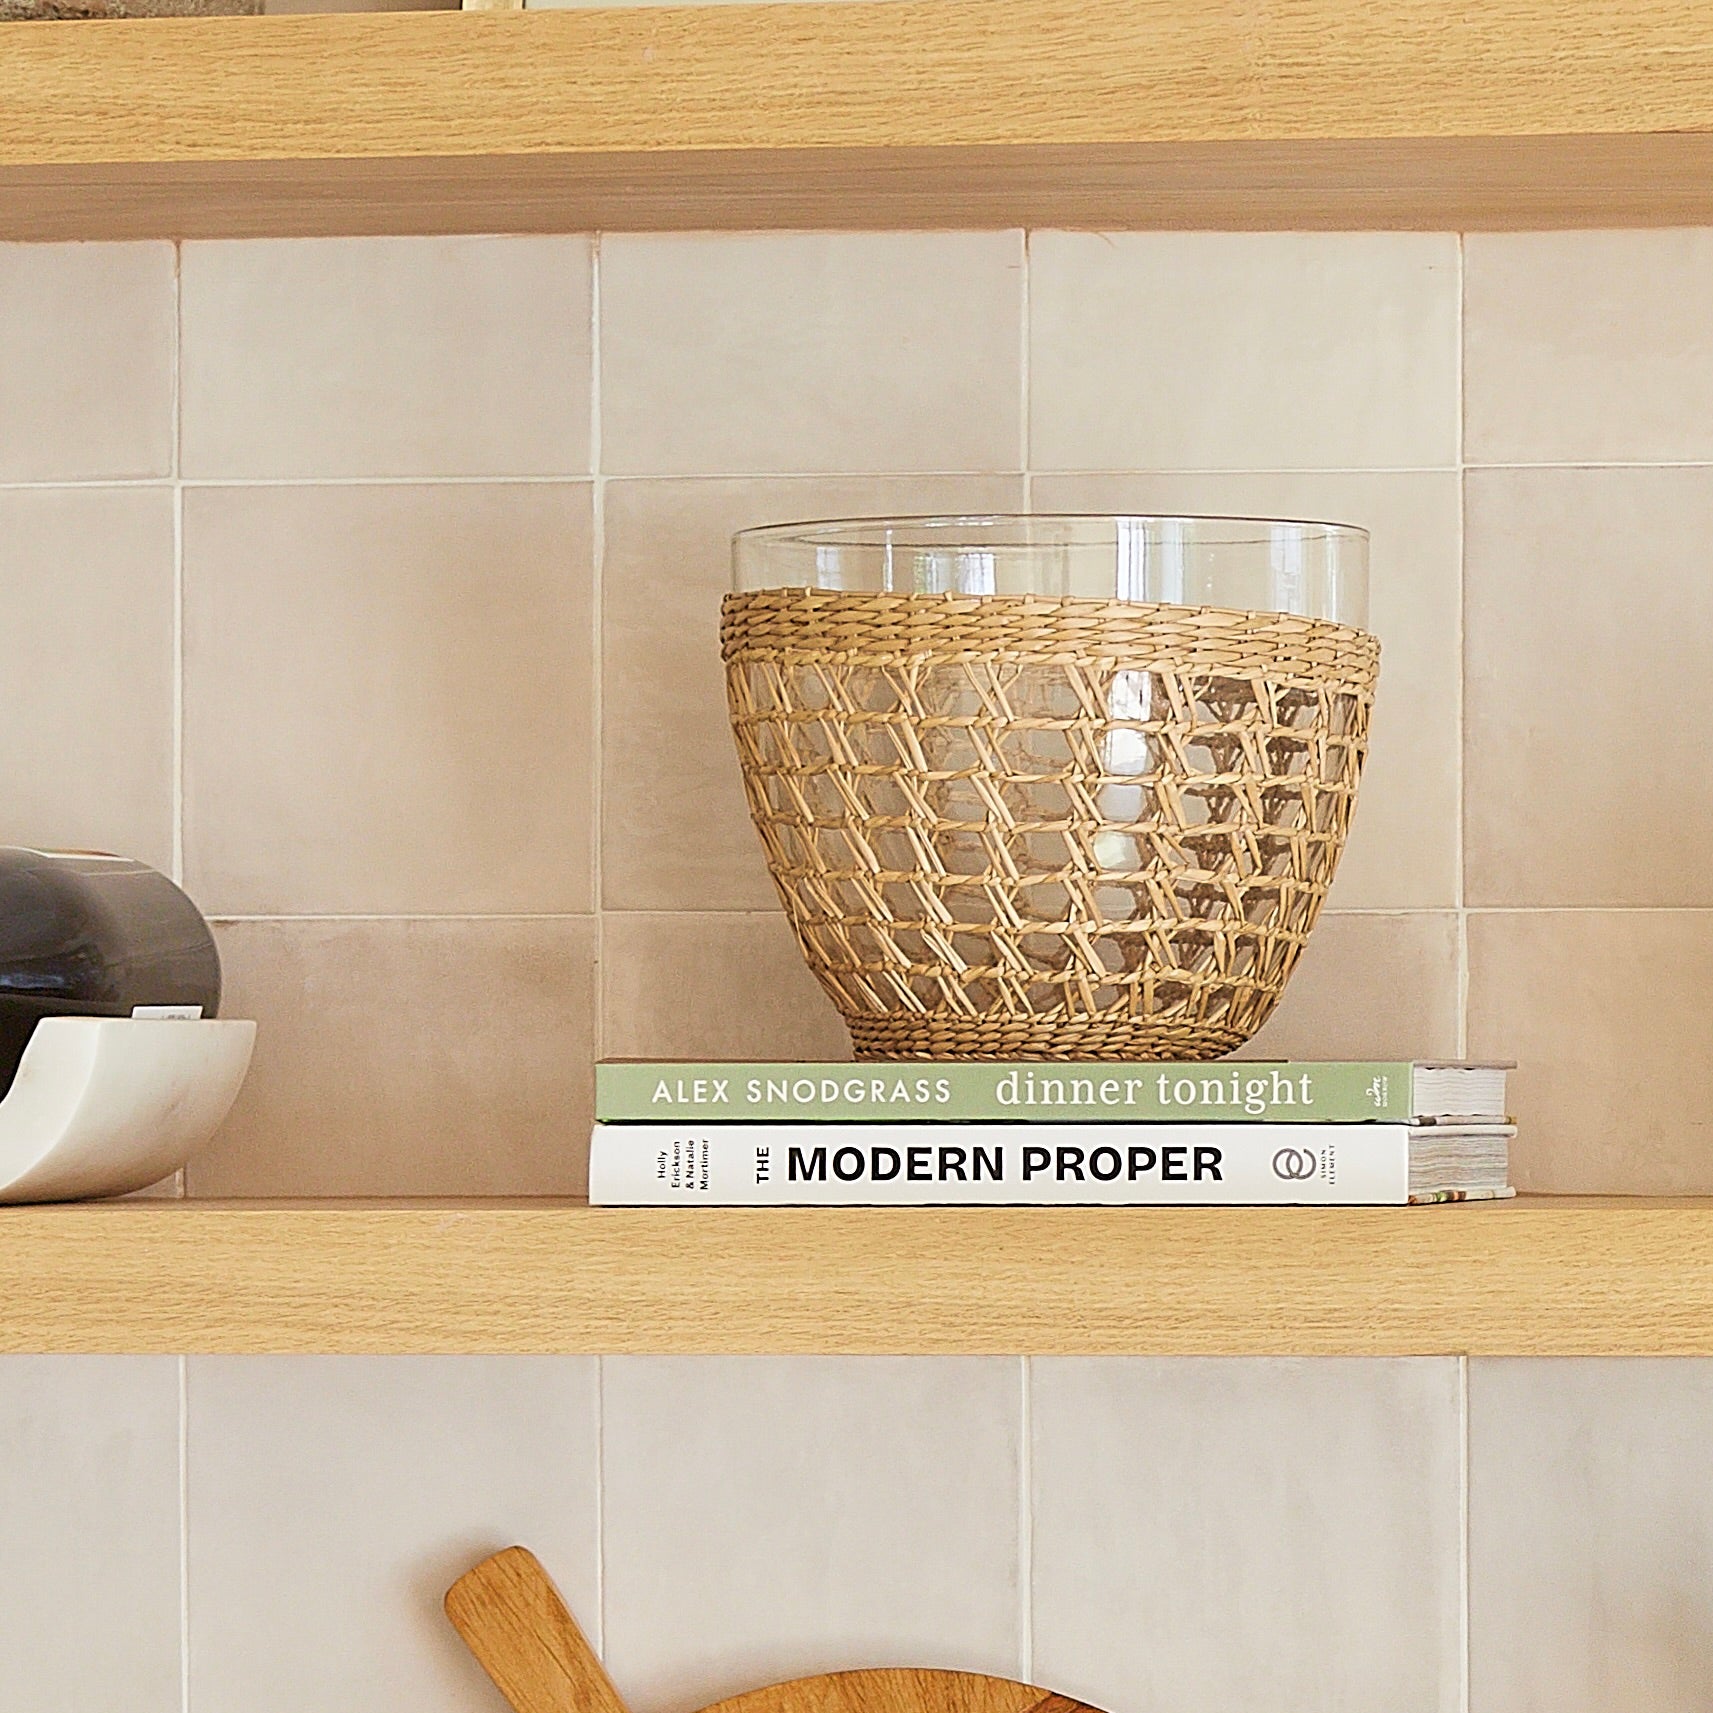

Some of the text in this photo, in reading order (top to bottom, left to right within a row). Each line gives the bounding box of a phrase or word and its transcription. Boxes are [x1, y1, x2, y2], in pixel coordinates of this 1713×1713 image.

[651, 1068, 1315, 1117] ALEX SNODGRASS dinner tonight
[657, 1150, 668, 1179] Holly
[671, 1140, 681, 1188] Erickson
[685, 1139, 695, 1190] & Natalie
[699, 1138, 709, 1190] Mortimer
[755, 1146, 771, 1184] THE
[787, 1146, 1224, 1182] MODERN PROPER
